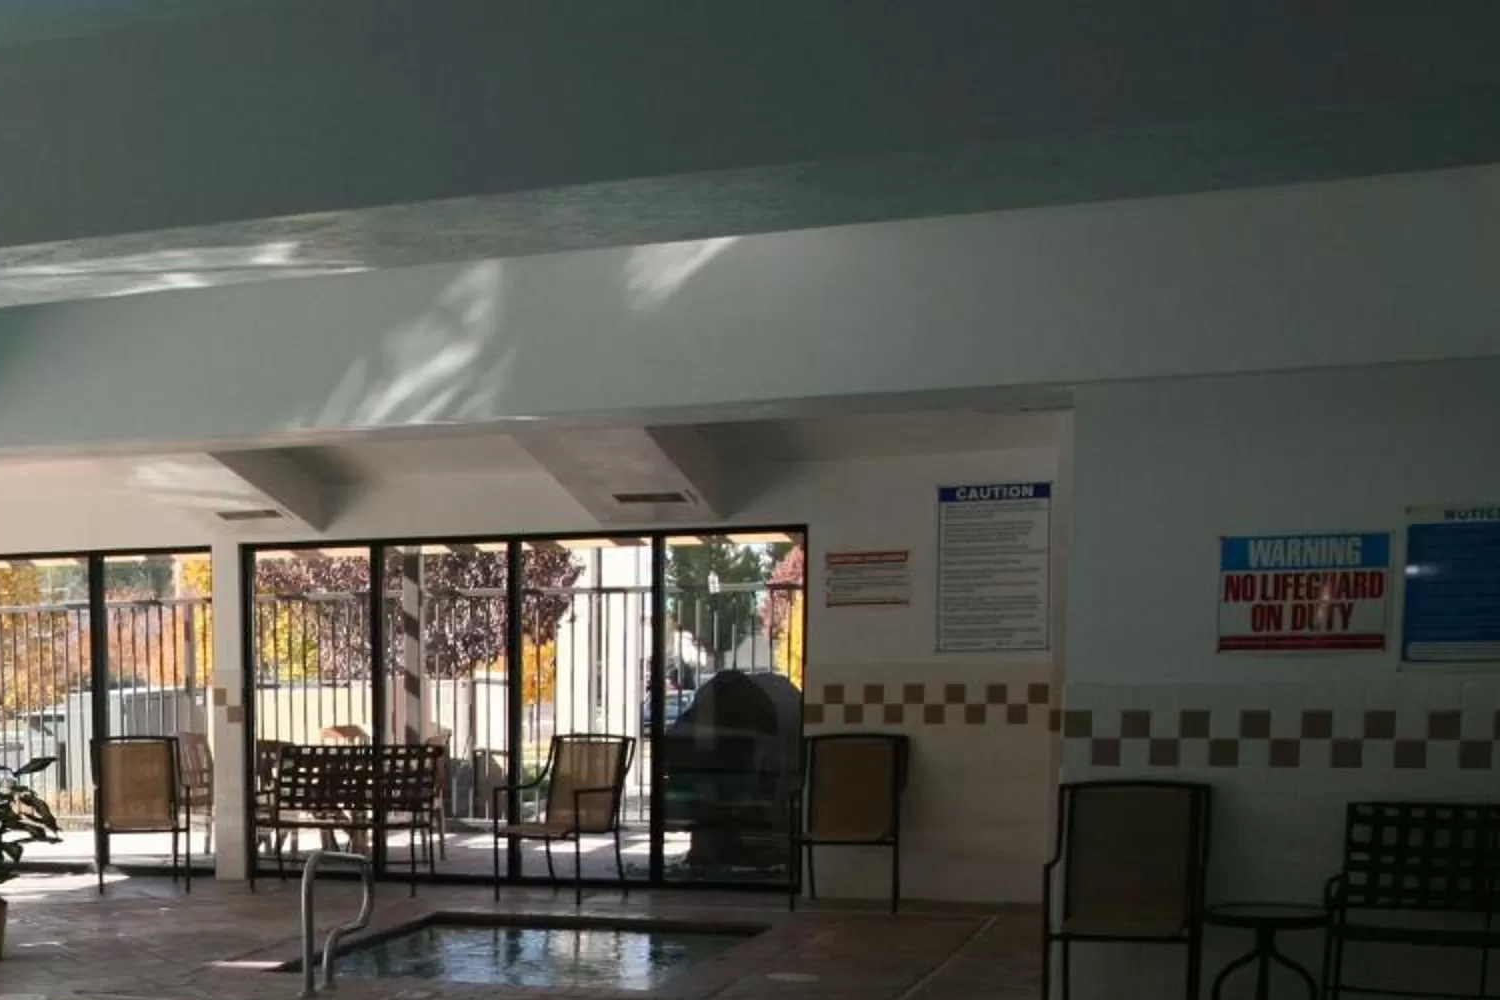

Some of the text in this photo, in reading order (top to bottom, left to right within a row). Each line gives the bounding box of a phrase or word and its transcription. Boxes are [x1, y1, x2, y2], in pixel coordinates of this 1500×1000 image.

[956, 486, 1035, 501] CAUTION
[1444, 507, 1500, 520] NOTIC
[1248, 536, 1362, 568] WARNING
[1224, 574, 1257, 603] NO
[1252, 604, 1283, 632] ON
